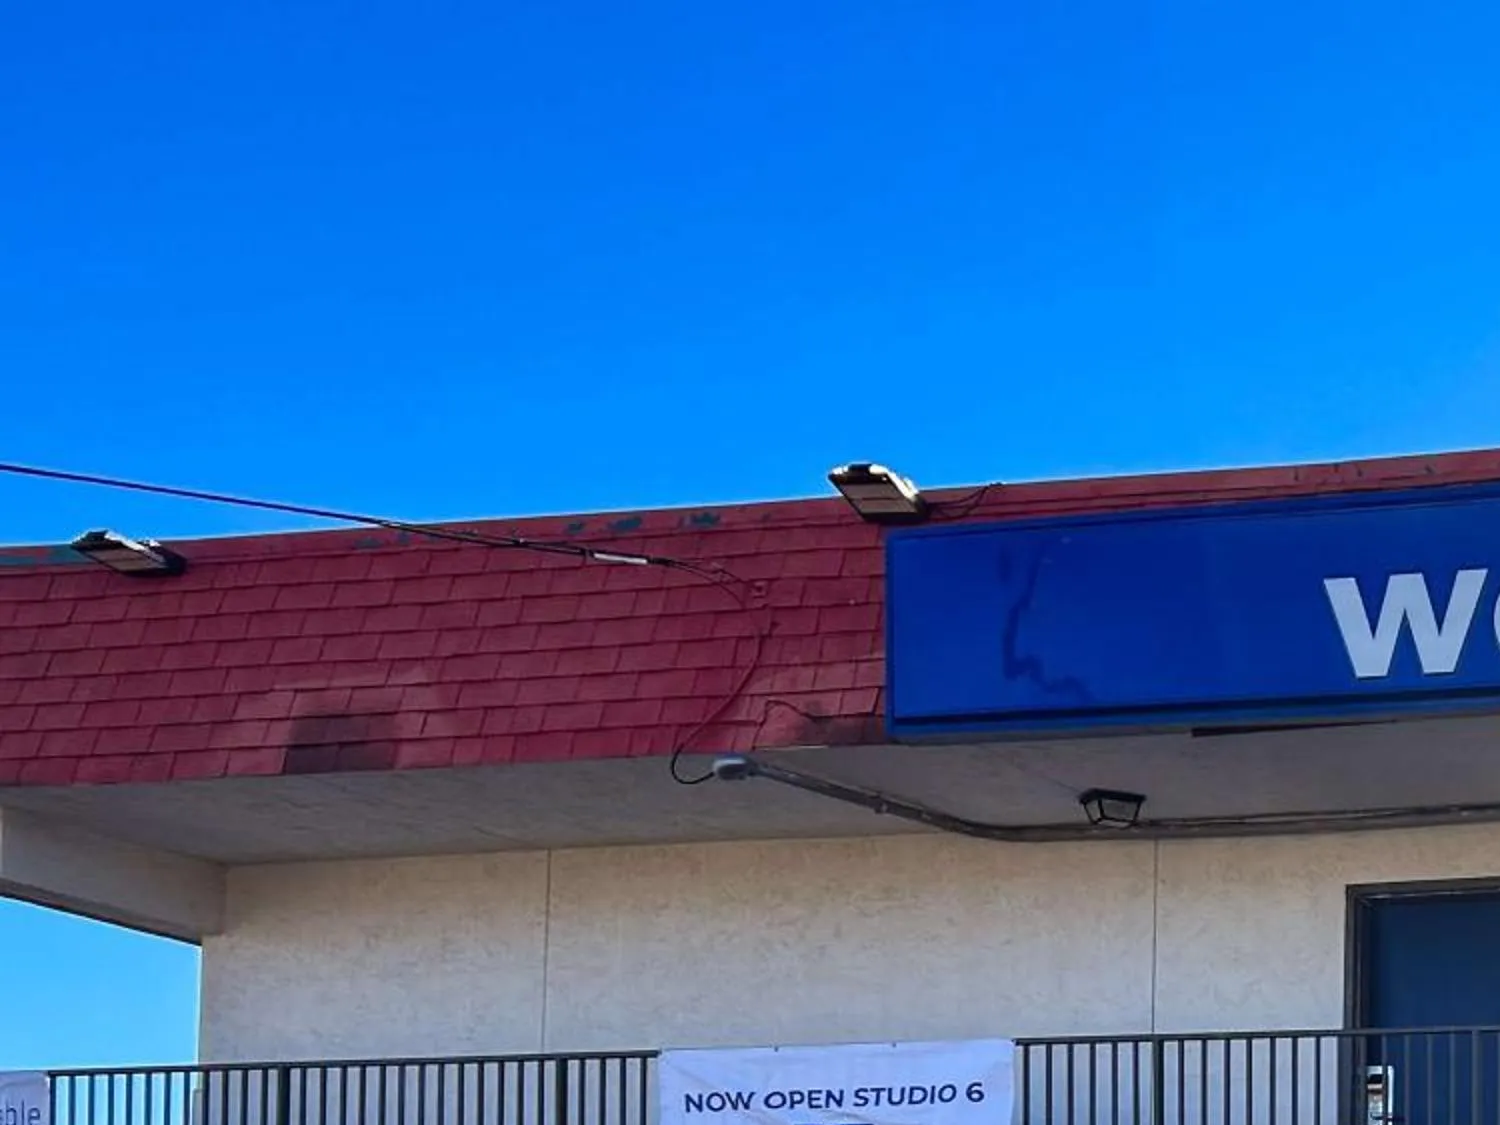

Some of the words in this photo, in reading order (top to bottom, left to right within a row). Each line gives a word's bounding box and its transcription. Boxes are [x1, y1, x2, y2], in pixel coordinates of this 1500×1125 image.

[683, 1090, 756, 1113] NOW
[763, 1088, 845, 1110] OPEN
[852, 1084, 957, 1107] STUDIO
[964, 1081, 986, 1103] 6
